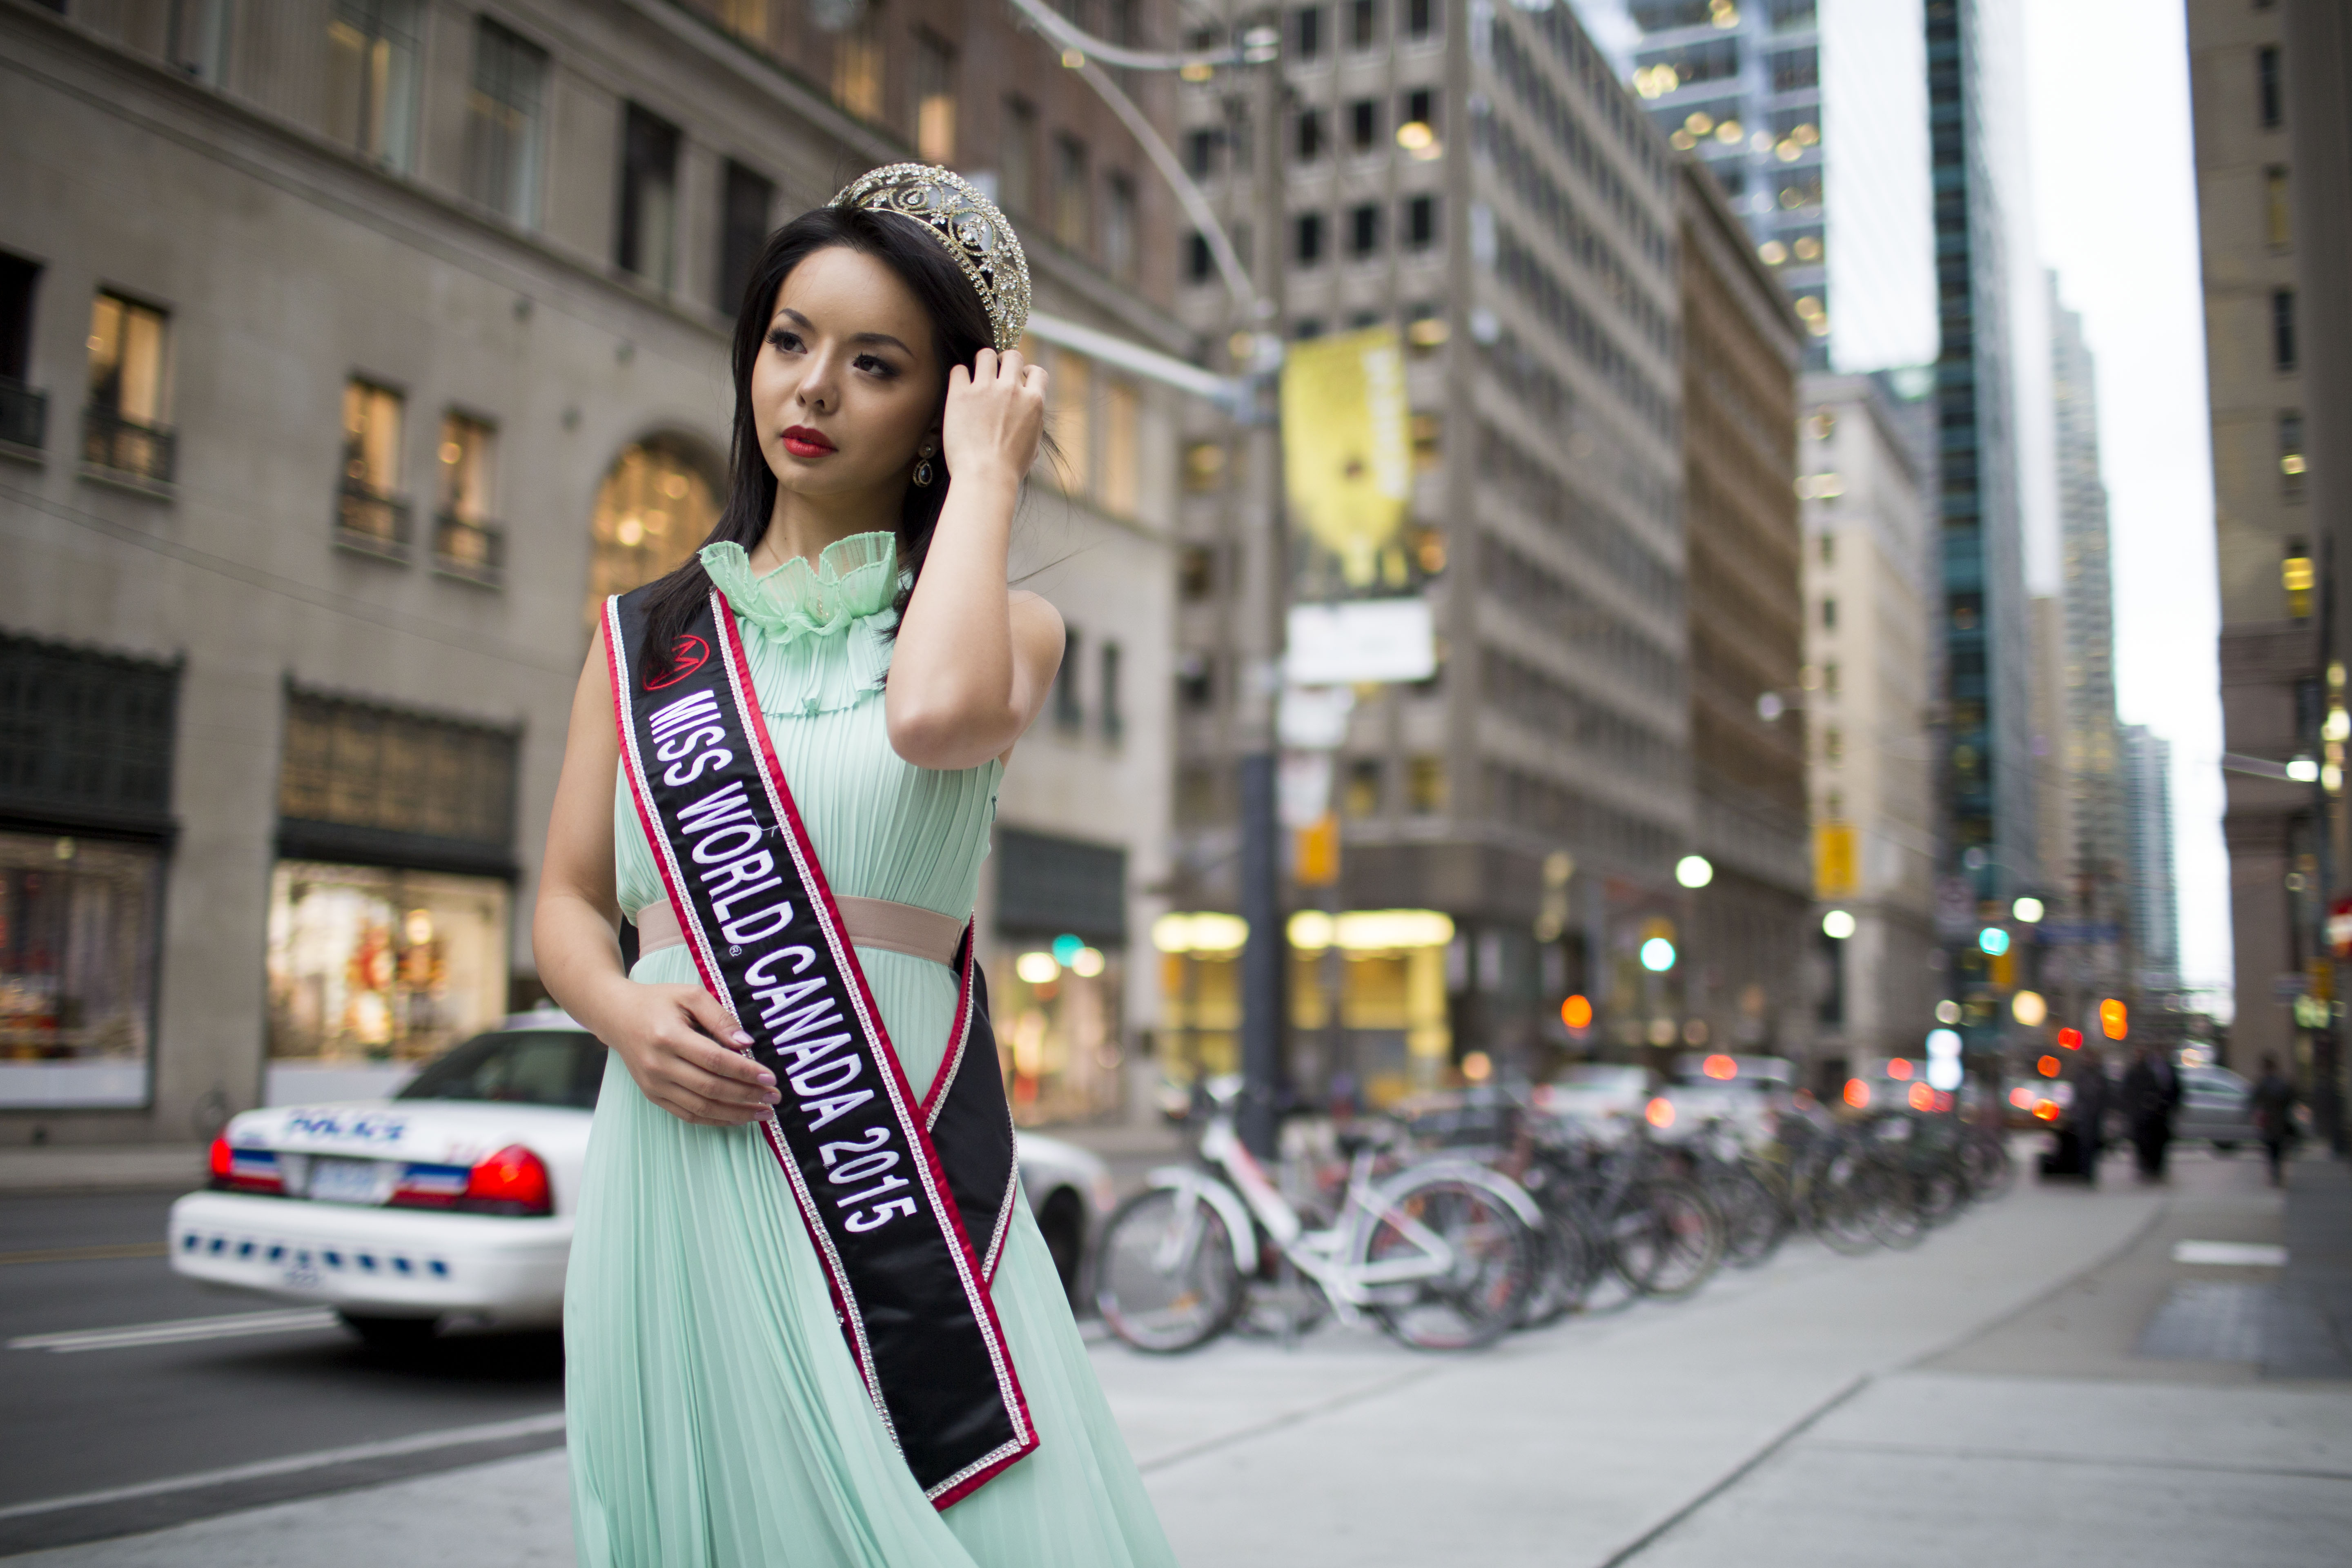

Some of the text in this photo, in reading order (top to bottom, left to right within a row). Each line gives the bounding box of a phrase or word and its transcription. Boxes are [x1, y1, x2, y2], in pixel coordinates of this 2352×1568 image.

[649, 690, 733, 786] MISS
[745, 945, 875, 1132] CANADA
[819, 1127, 917, 1232] 2015
